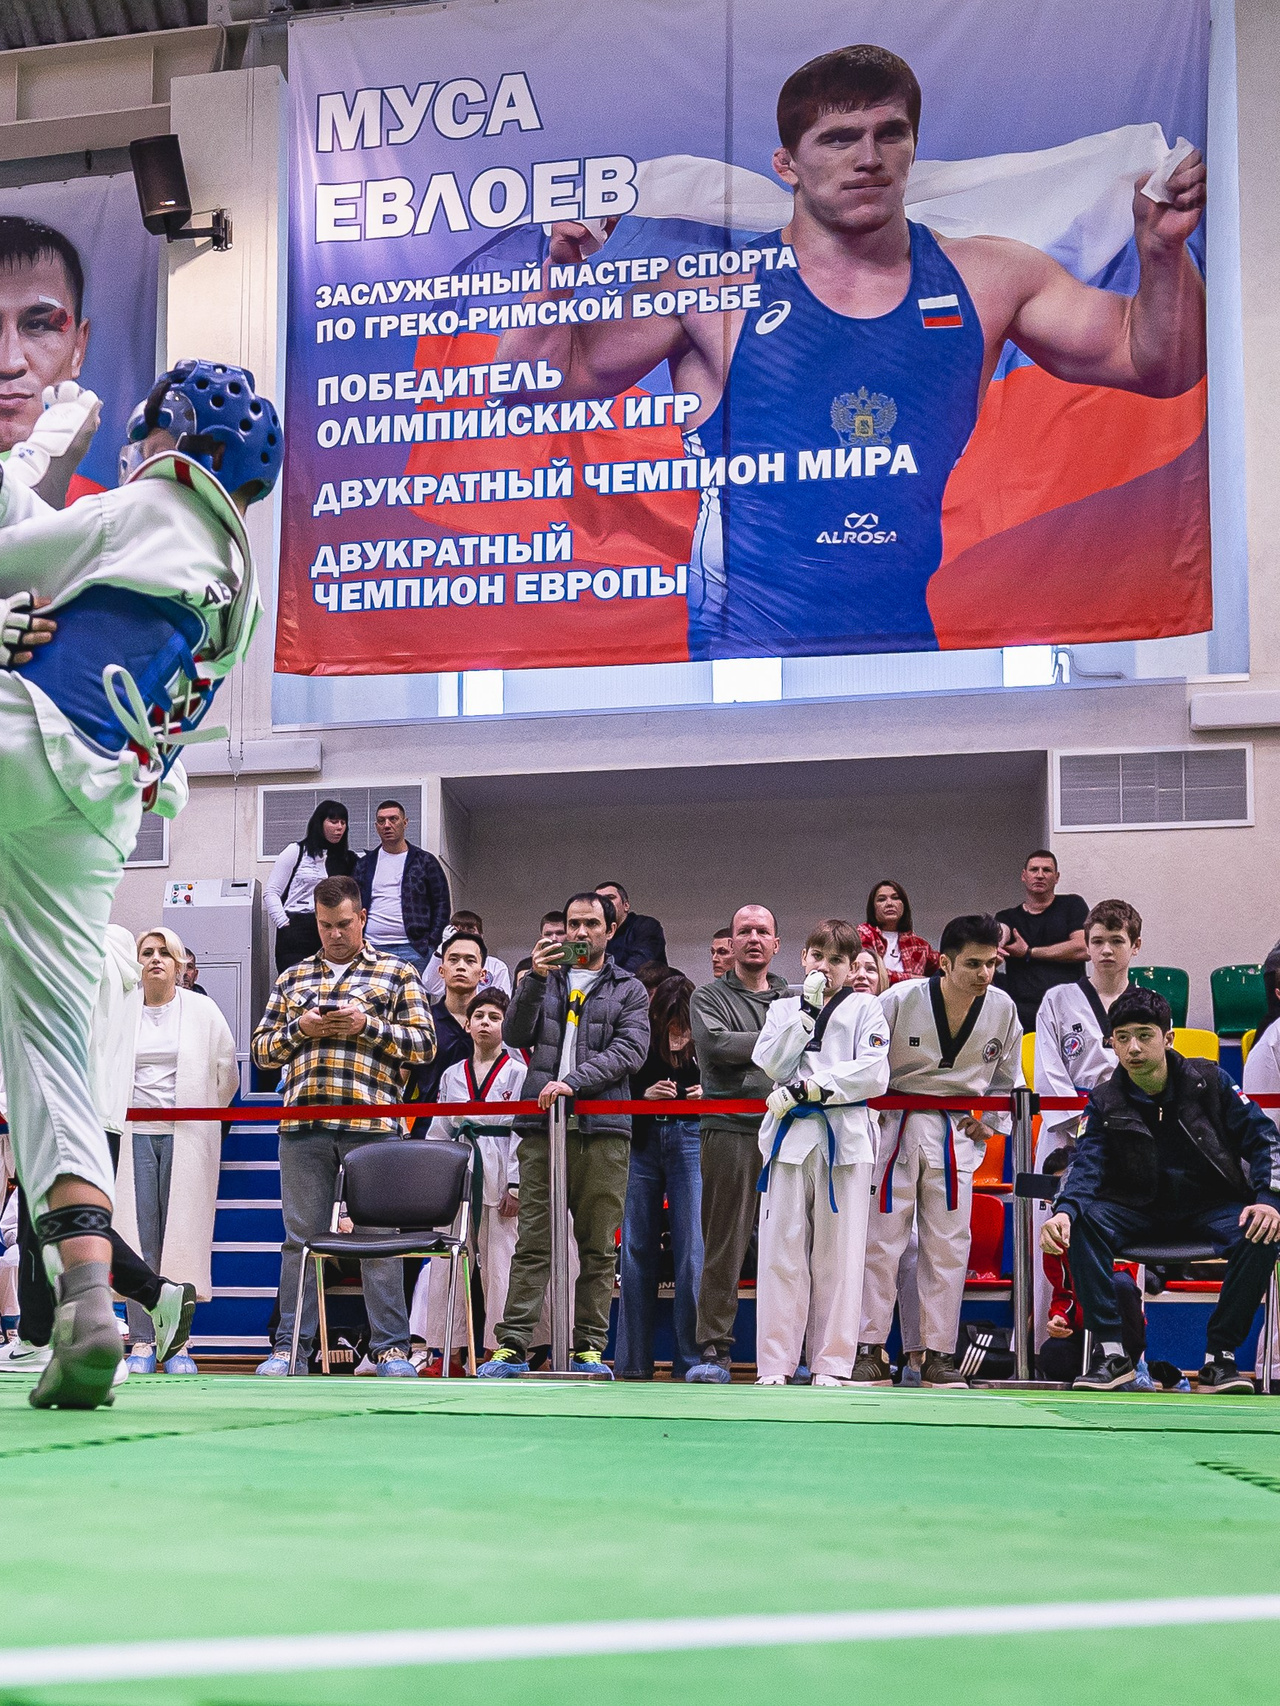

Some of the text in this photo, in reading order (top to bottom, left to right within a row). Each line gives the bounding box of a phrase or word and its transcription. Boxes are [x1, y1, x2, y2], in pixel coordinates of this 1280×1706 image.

[317, 72, 543, 154] МУСА
[316, 155, 638, 243] ЕВЛОЕВ
[316, 246, 797, 308] ЗАСЛУЖЕННЫЙ МАСТЕР СПОРТА
[317, 285, 761, 343] ПО ГРЕКО-РИМСКОЙ БОРЬБЕ
[317, 360, 562, 406] ПОБЕДИТЕЛЬ
[317, 394, 700, 448] ОЛИМПИЙСКИХ ИГР
[313, 445, 917, 517] ДВУКРАТНЫЙ ЧЕМПИОН МИРА
[311, 523, 572, 579] ДВУКРАТНЫЙ
[816, 531, 897, 544] ALROSA
[314, 566, 686, 612] ЧЕМПИОН ЕВРОПЫ
[314, 1349, 354, 1363] PMA
